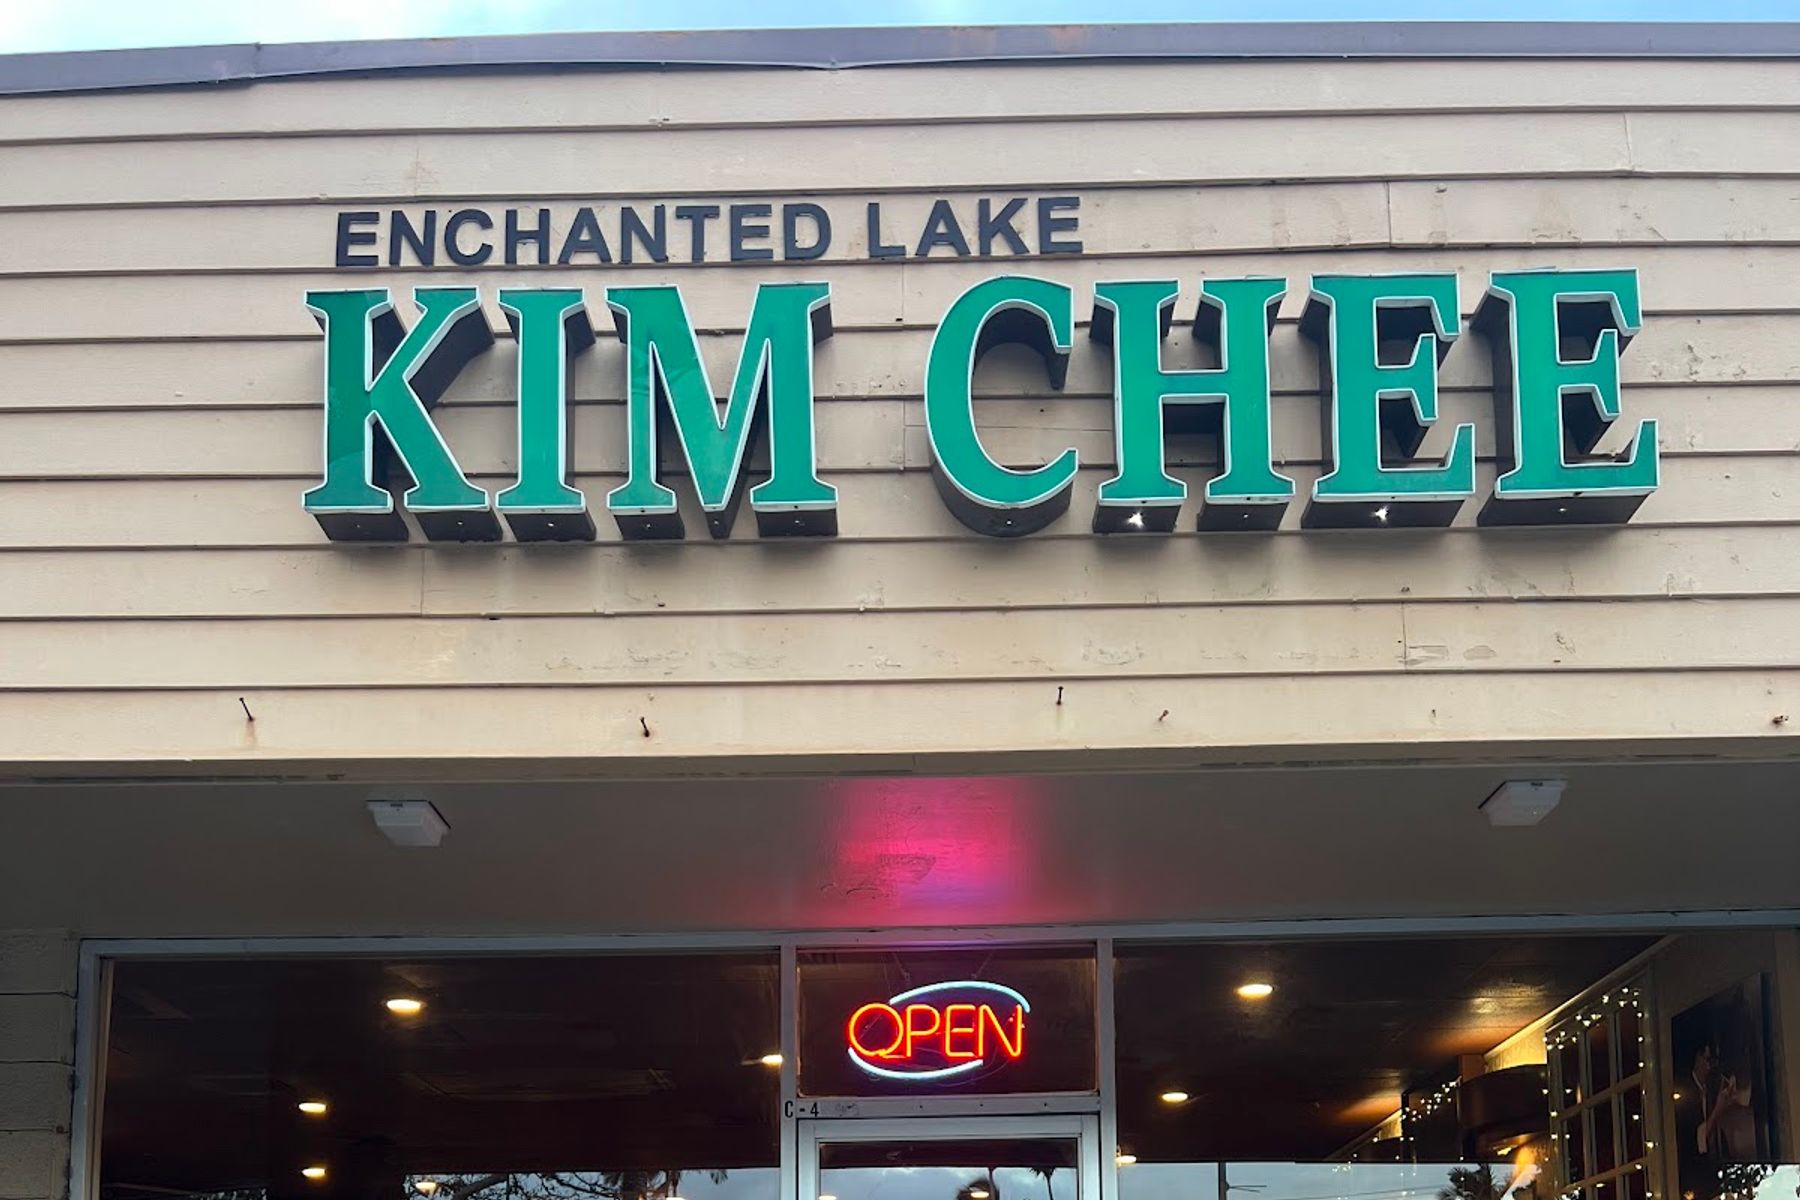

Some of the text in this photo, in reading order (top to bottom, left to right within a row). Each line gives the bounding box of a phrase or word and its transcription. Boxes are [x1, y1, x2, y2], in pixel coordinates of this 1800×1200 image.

[335, 196, 1083, 267] ENCHANTED LAKE
[302, 267, 1660, 512] KIM CHEE
[849, 1002, 1024, 1059] OPEN
